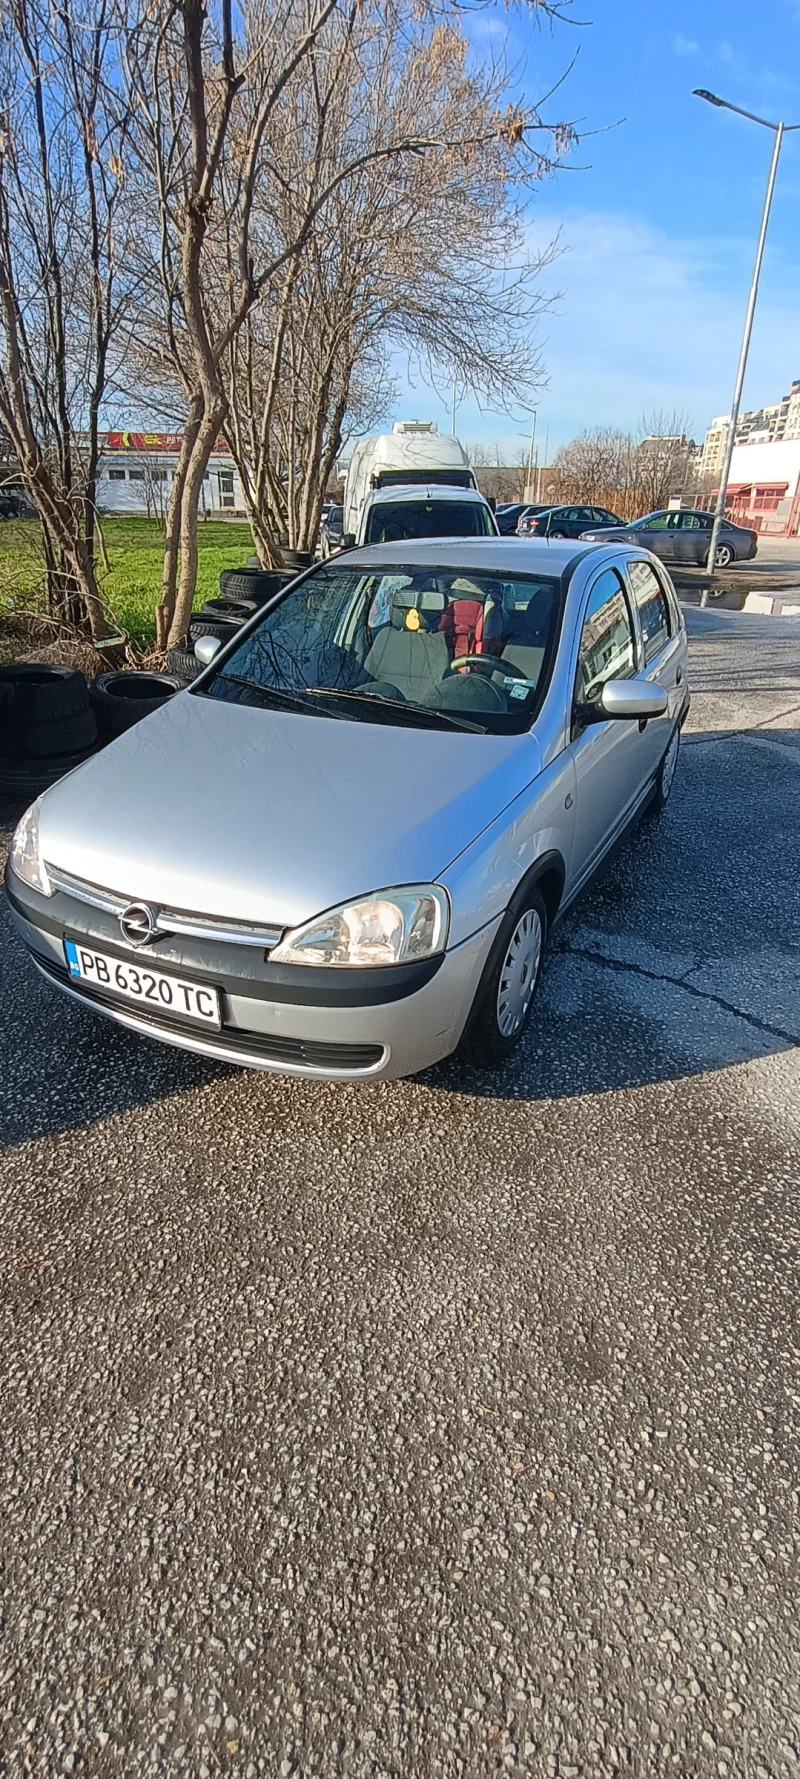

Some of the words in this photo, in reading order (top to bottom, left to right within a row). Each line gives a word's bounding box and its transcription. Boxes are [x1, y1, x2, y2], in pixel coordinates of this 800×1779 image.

[166, 436, 183, 444] PET
[69, 961, 80, 971] BG
[80, 950, 110, 983] PB
[115, 964, 173, 1005] 6320
[178, 983, 214, 1017] TC
